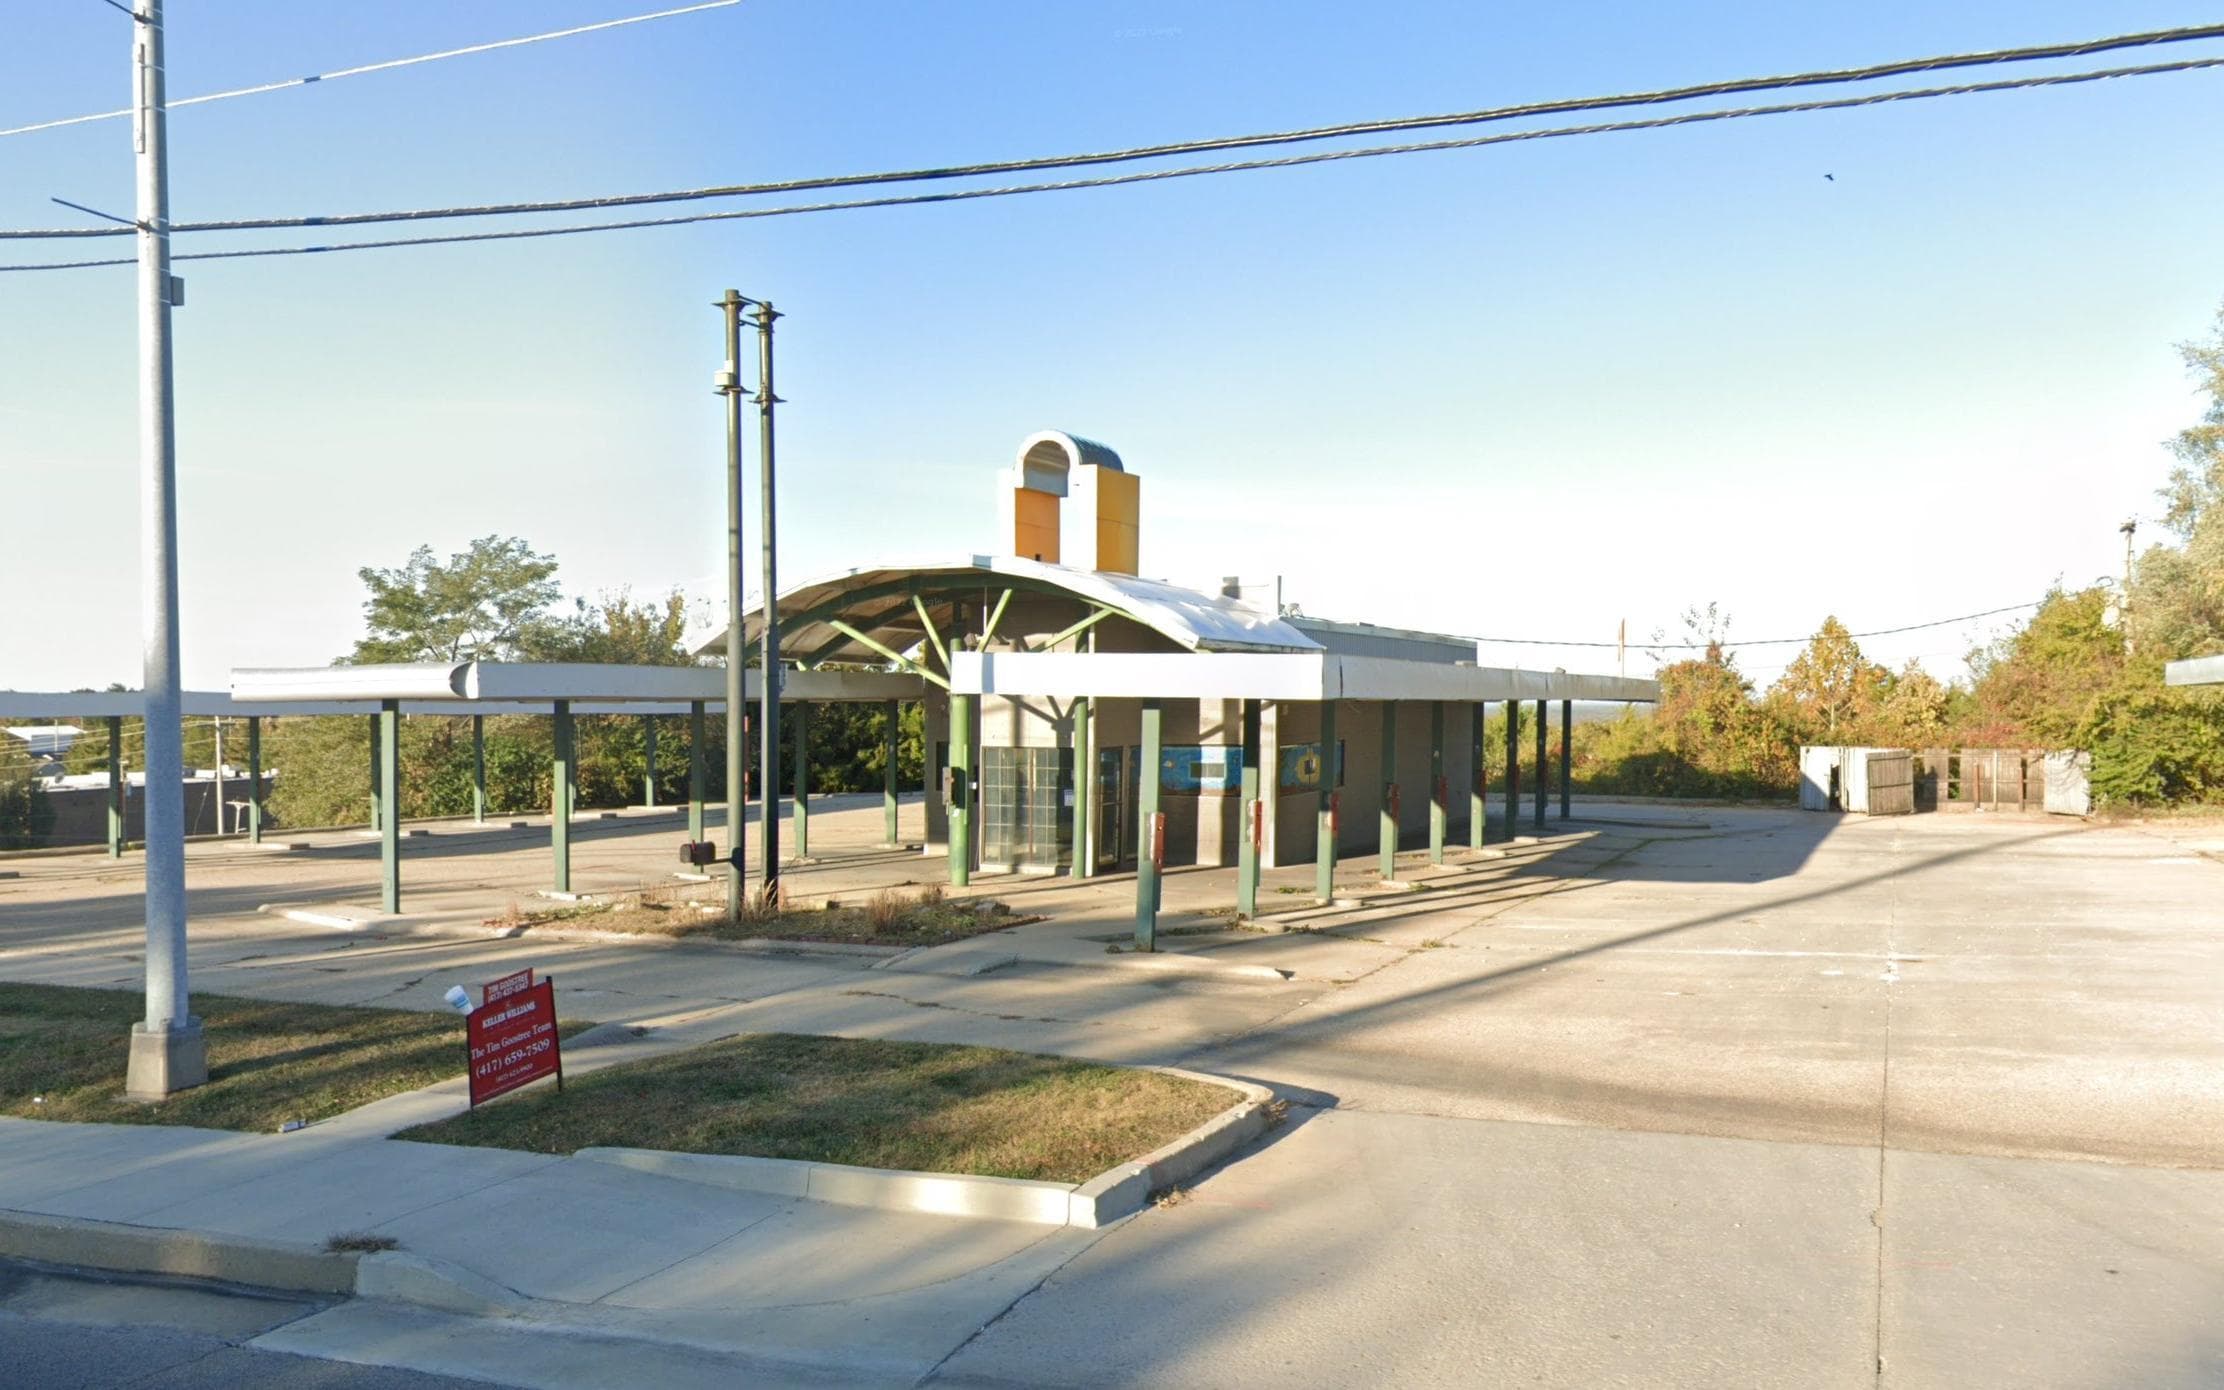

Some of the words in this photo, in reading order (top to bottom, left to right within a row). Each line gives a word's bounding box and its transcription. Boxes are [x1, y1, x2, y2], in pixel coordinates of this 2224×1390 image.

[482, 1012, 506, 1029] KELLER
[506, 1001, 536, 1019] WILLIAMS
[471, 1048, 485, 1060] The
[486, 1041, 501, 1054] Tim
[532, 1022, 553, 1035] Team
[475, 1058, 502, 1080] (417)
[504, 1038, 551, 1066] 659-7509
